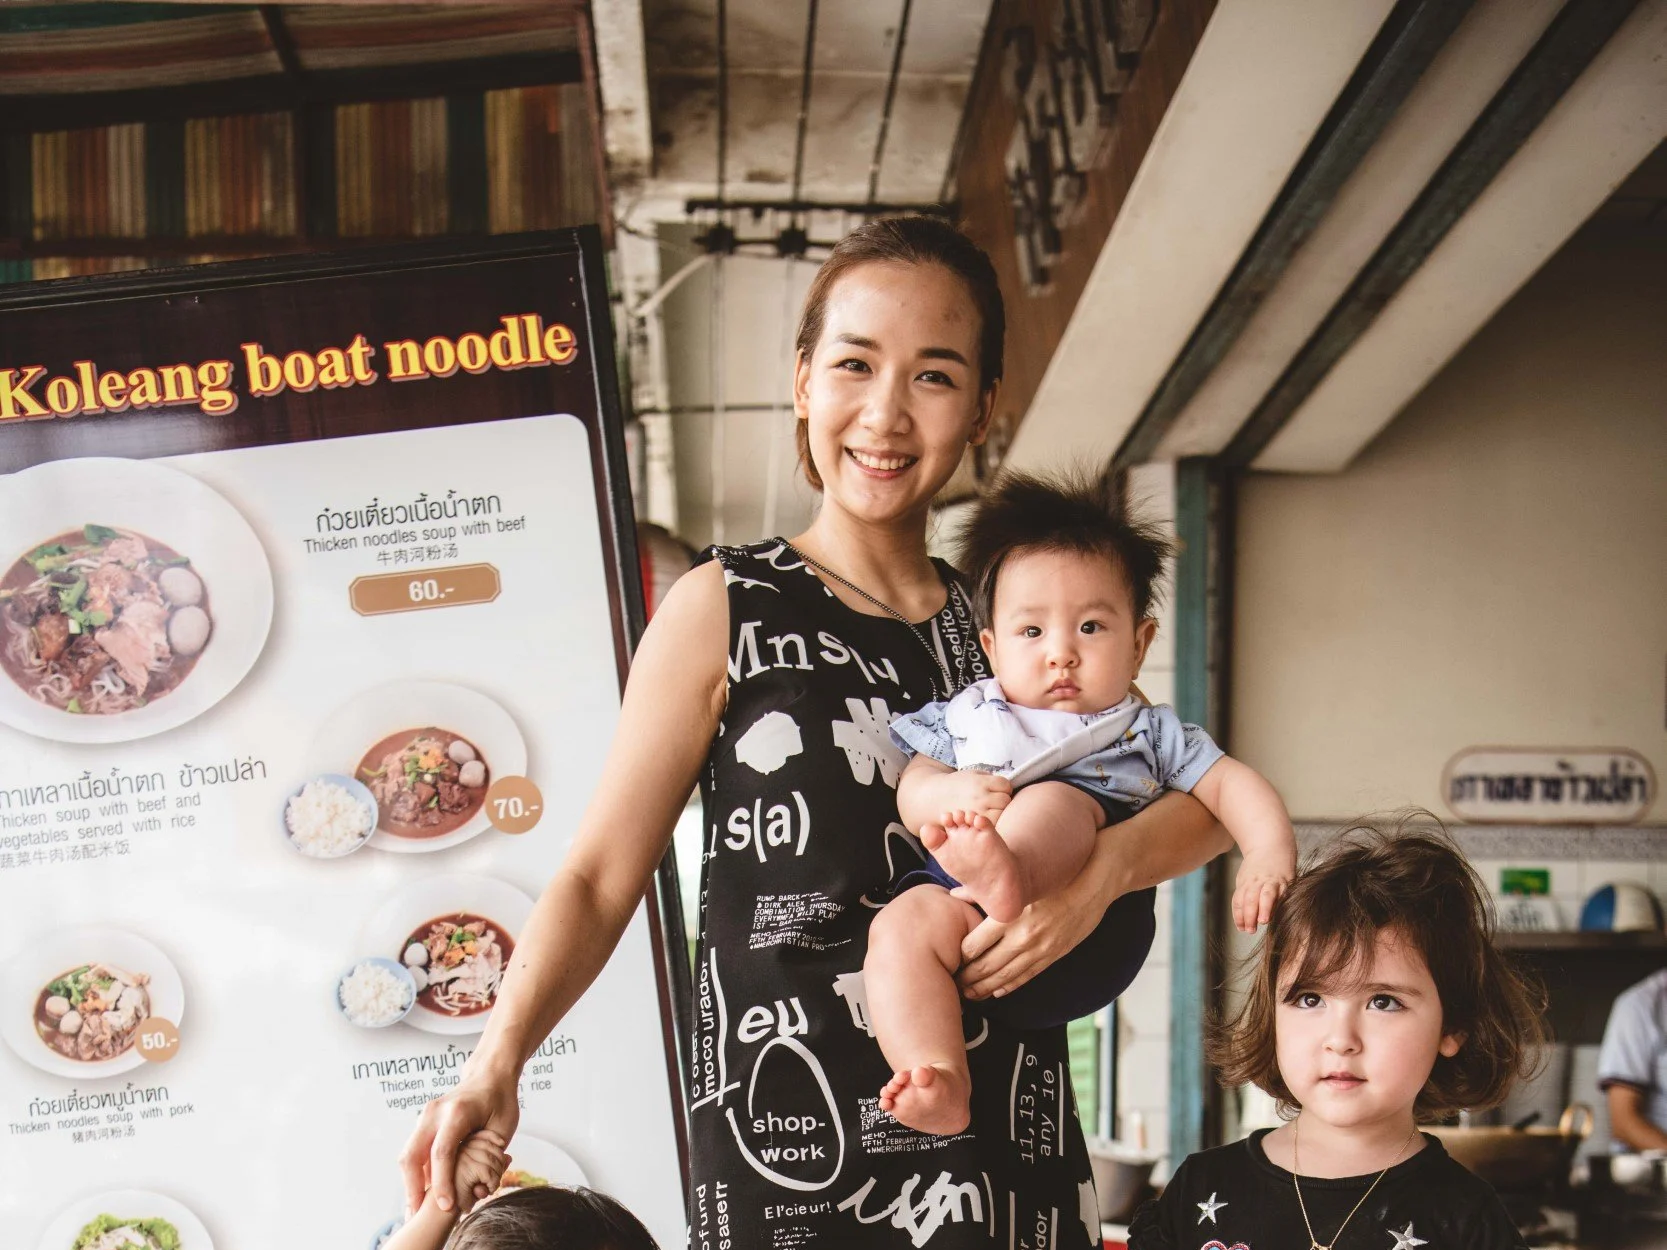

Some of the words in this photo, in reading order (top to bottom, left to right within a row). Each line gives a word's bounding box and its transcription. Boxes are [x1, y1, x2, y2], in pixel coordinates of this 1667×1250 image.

[0, 360, 238, 419] Koleang
[240, 335, 375, 397] boat
[384, 313, 577, 380] noodle
[303, 536, 358, 554] Thicken
[363, 529, 418, 547] noodles
[422, 525, 457, 543] soup
[461, 520, 492, 536] with
[496, 515, 527, 532] beef
[376, 543, 460, 567] 牛肉河粉汤
[408, 578, 455, 602] 60.-
[56, 807, 91, 823] soup
[99, 801, 129, 818] with
[137, 795, 168, 814] beef
[176, 792, 202, 808] and
[493, 797, 540, 819] 70.-
[77, 821, 124, 840] served
[132, 816, 162, 833] with
[170, 813, 196, 829] rice
[142, 1031, 178, 1050] 50.-
[380, 1078, 425, 1093] Thicken
[431, 1074, 461, 1089] soup
[532, 1062, 554, 1076] and
[531, 1079, 552, 1091] rice
[8, 1120, 51, 1135] Thicken
[57, 1115, 100, 1130] noodles
[106, 1111, 134, 1125] soup
[139, 1107, 163, 1121] with
[170, 1102, 195, 1118] pork
[752, 1111, 826, 1135] shop-
[760, 1144, 826, 1164] work
